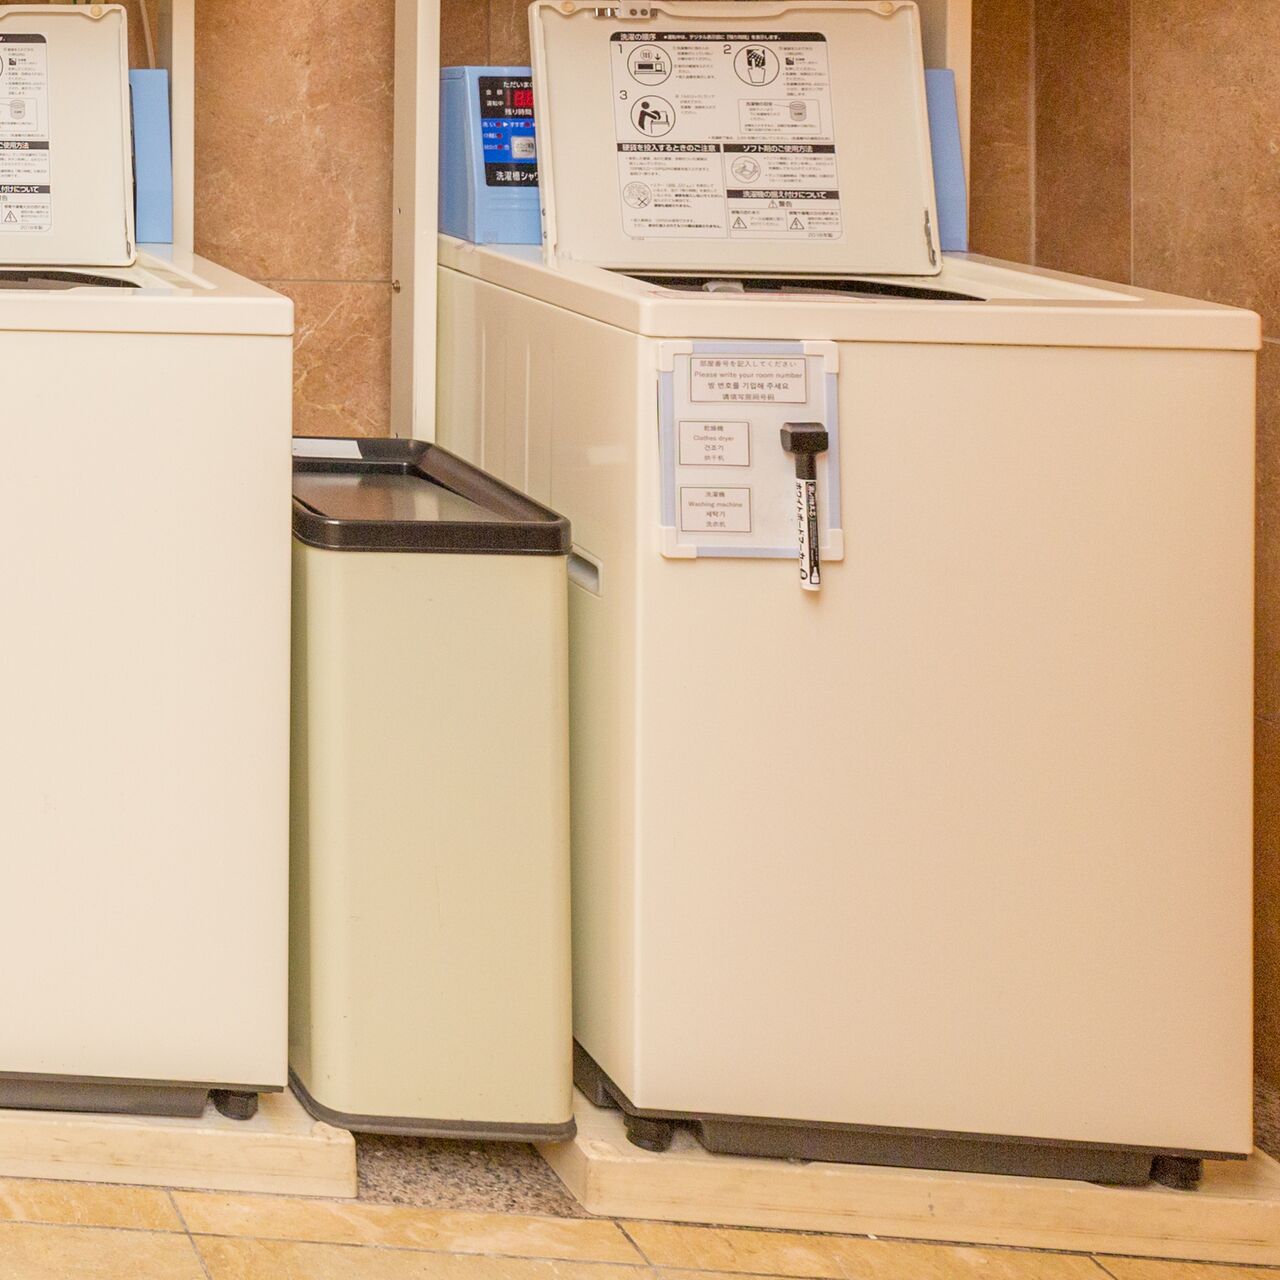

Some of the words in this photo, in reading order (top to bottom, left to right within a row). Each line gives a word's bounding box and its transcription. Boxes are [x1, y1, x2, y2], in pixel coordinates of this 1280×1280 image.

[618, 43, 623, 54] 1
[723, 44, 732, 54] 2
[619, 90, 628, 100] 3
[739, 372, 754, 380] your
[775, 371, 803, 379] number
[766, 382, 789, 390] 주세요
[718, 434, 734, 442] dryer
